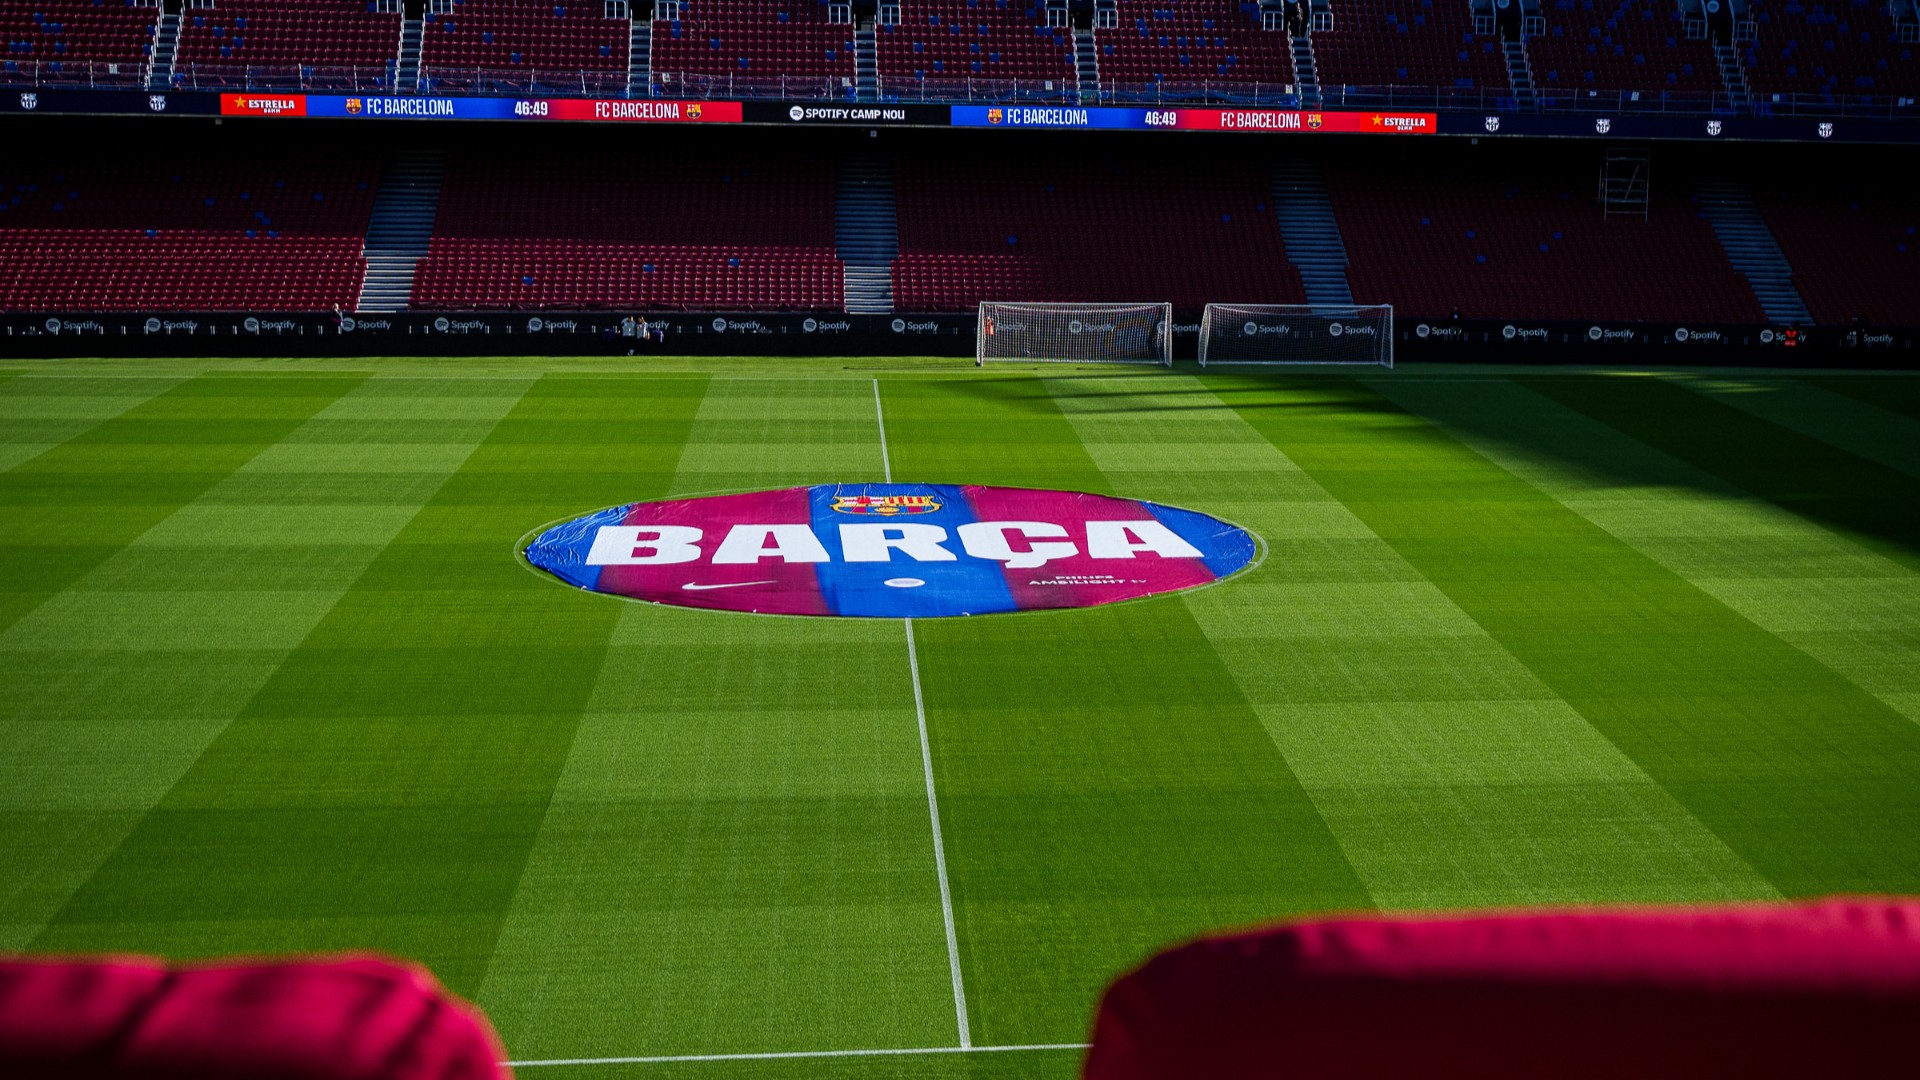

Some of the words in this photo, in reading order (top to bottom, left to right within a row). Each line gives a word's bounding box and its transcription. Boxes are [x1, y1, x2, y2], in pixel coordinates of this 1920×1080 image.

[248, 99, 295, 109] ESTRELLA
[366, 98, 382, 115] FC
[384, 98, 454, 116] BARCELONA
[514, 101, 549, 117] 46:49
[595, 102, 610, 118] FC
[612, 102, 680, 119] BARCELONA
[805, 108, 849, 119] SPOTIFY
[850, 108, 882, 120] CAMP
[882, 109, 905, 120] NOU
[1007, 108, 1021, 124] FC
[1023, 108, 1088, 125] BARCELONA
[1144, 111, 1177, 126] 46:49
[1221, 111, 1235, 128] FC
[1236, 112, 1301, 129] BARCELONA
[1384, 117, 1426, 127] ESTRELLA
[63, 320, 99, 332] Spotify
[163, 320, 198, 331] Spotify
[261, 319, 296, 331] Spotify
[357, 319, 392, 331] Spotify
[451, 319, 484, 331] Spotify
[544, 319, 578, 331] Spotify
[728, 319, 761, 331] Spotify
[819, 320, 851, 331] Spotify
[907, 320, 939, 332] Spotify
[1259, 323, 1290, 334] Spotify
[1344, 324, 1376, 335] Spotify
[1517, 327, 1548, 337] Spotify
[1603, 328, 1635, 339] Spotify
[1690, 330, 1721, 341] Spotify
[1862, 333, 1894, 344] Spotify
[585, 520, 1204, 569] BARÇA
